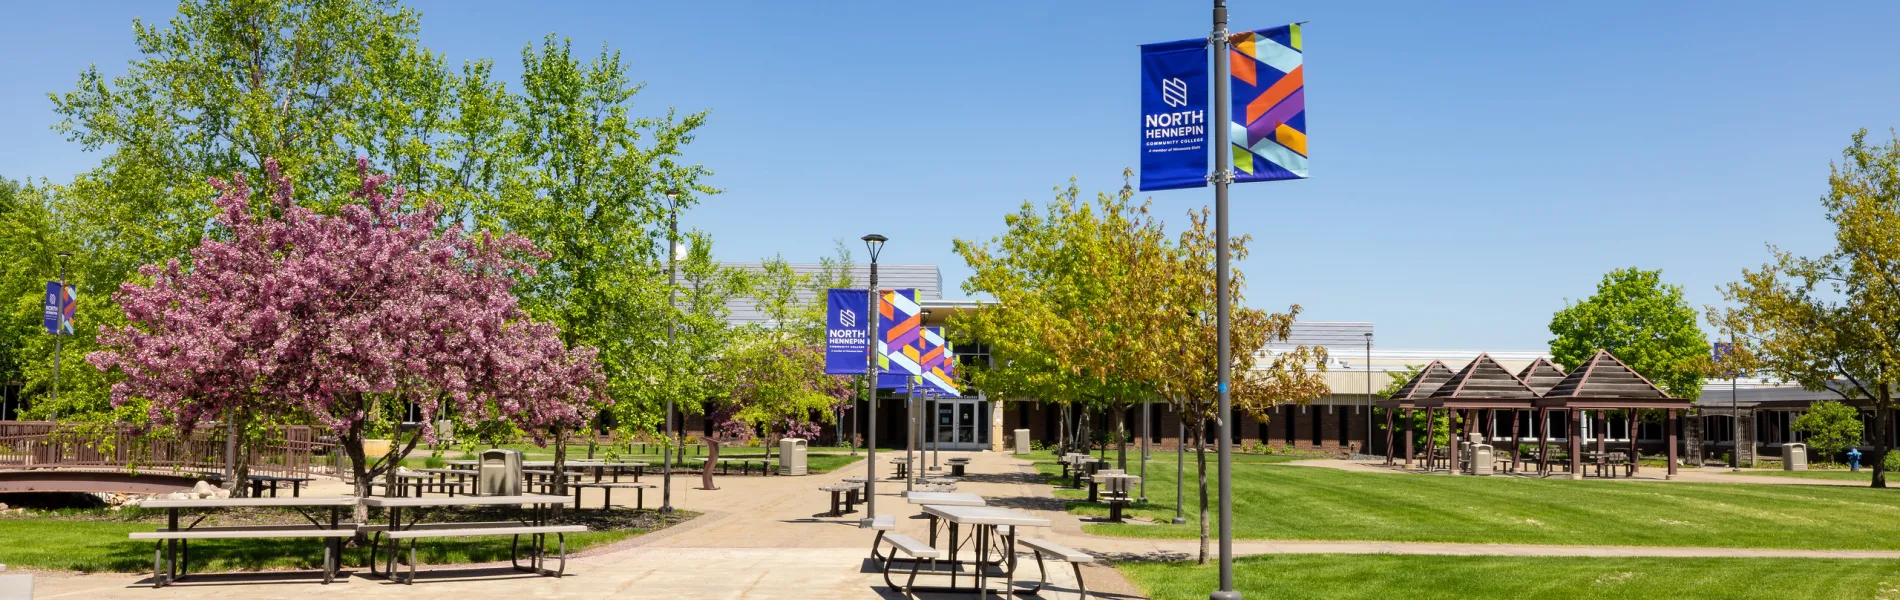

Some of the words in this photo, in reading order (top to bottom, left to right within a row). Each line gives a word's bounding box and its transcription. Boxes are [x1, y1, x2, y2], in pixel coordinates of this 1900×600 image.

[1146, 110, 1204, 128] NORTH
[1146, 125, 1204, 138] HENNEPIN
[830, 329, 865, 338] NORTH
